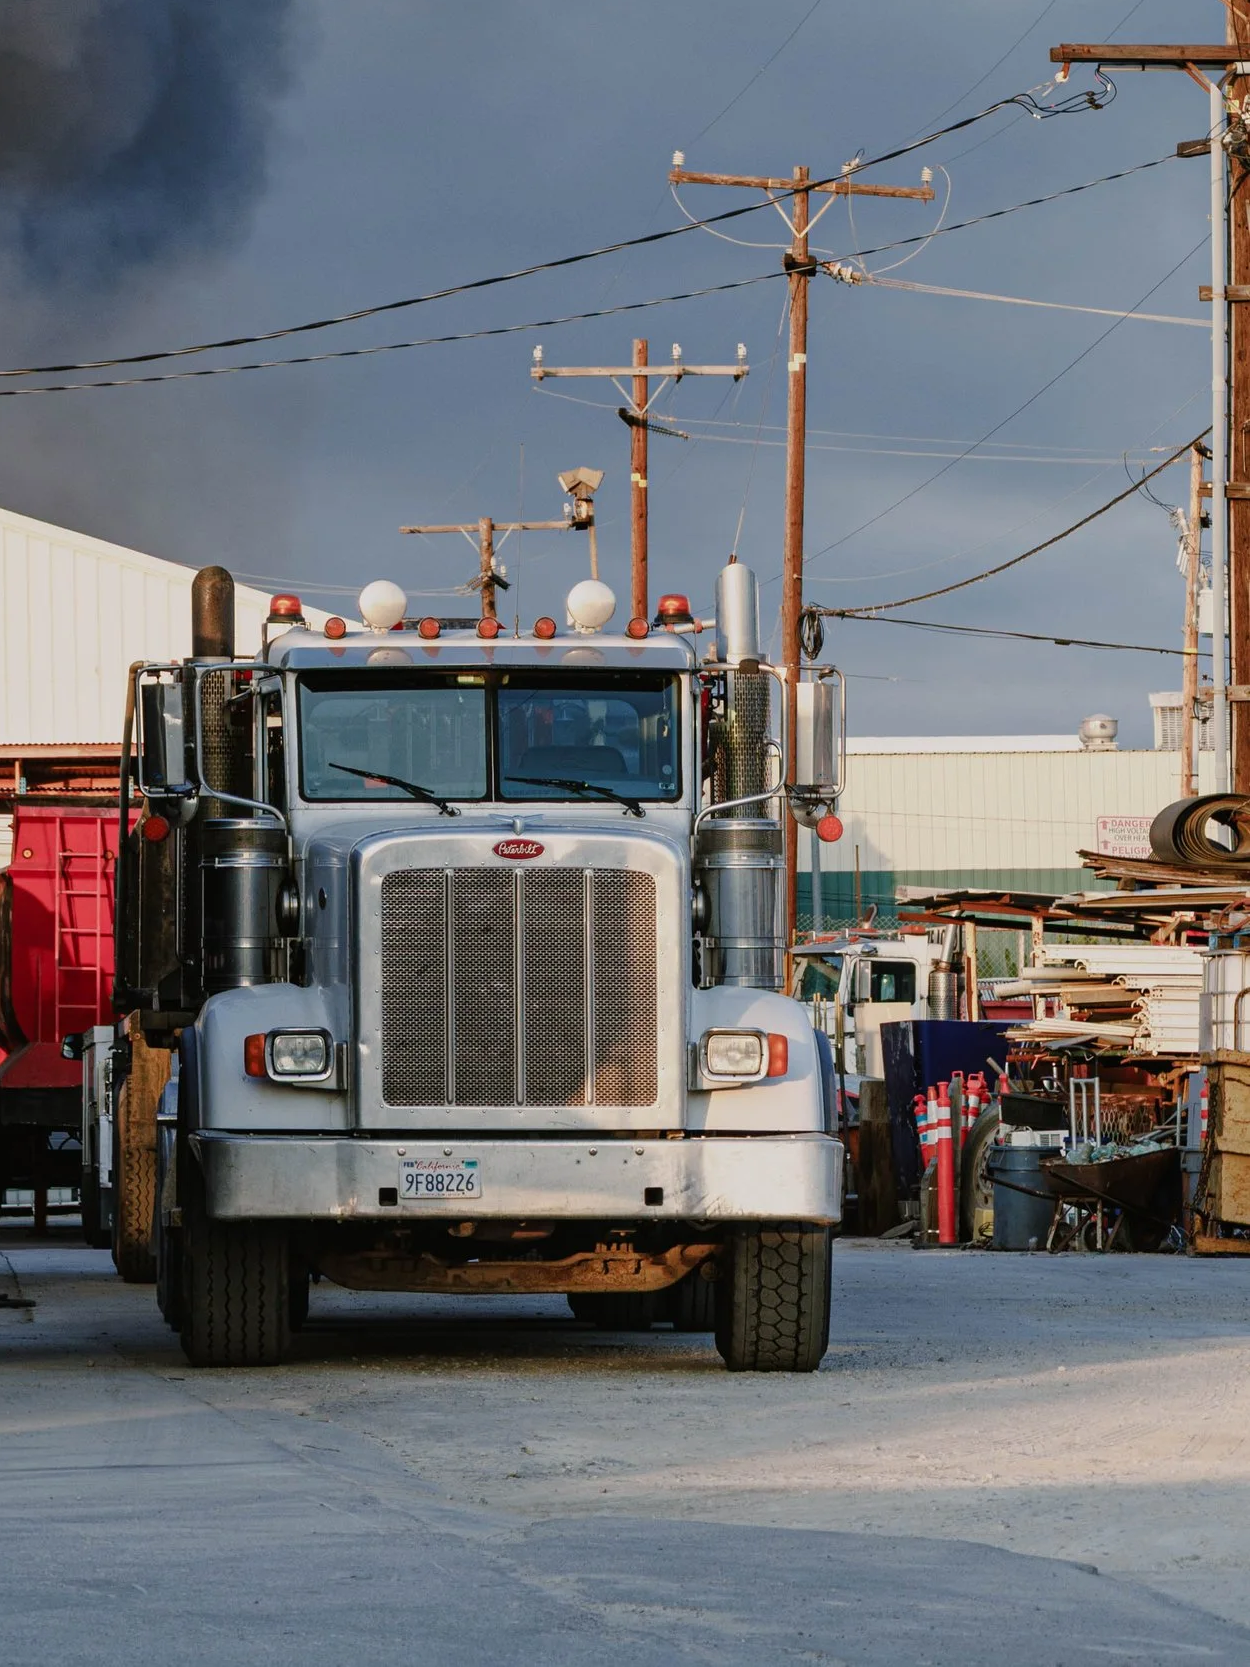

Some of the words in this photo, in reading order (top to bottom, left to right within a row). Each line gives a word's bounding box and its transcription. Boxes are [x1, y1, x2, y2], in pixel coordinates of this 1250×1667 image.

[498, 842, 541, 855] Peterbilt
[415, 1160, 462, 1172] California
[405, 1174, 475, 1192] 9F88226
